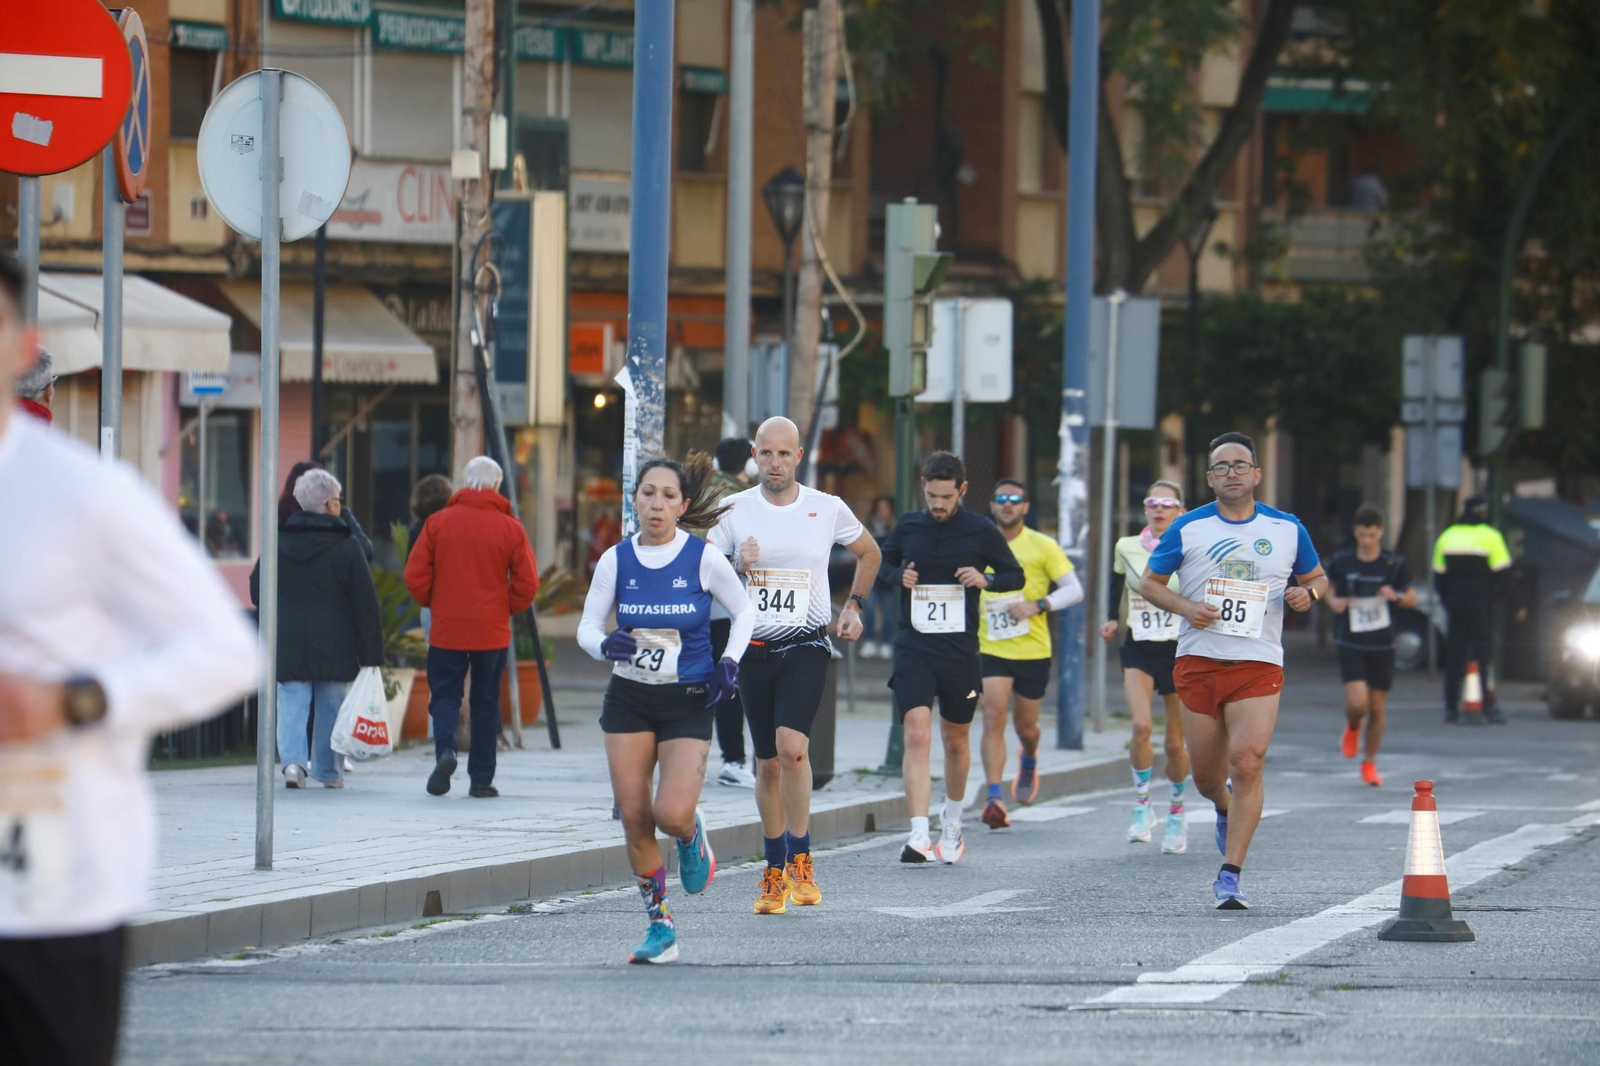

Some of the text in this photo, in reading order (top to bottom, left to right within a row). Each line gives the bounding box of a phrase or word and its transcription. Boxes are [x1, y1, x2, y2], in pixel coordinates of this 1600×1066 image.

[619, 603, 697, 615] TROTASIERRA
[758, 588, 796, 613] 344
[927, 602, 946, 620] 21
[1221, 598, 1247, 623] 85
[1141, 611, 1173, 629] 812
[629, 648, 665, 672] 29
